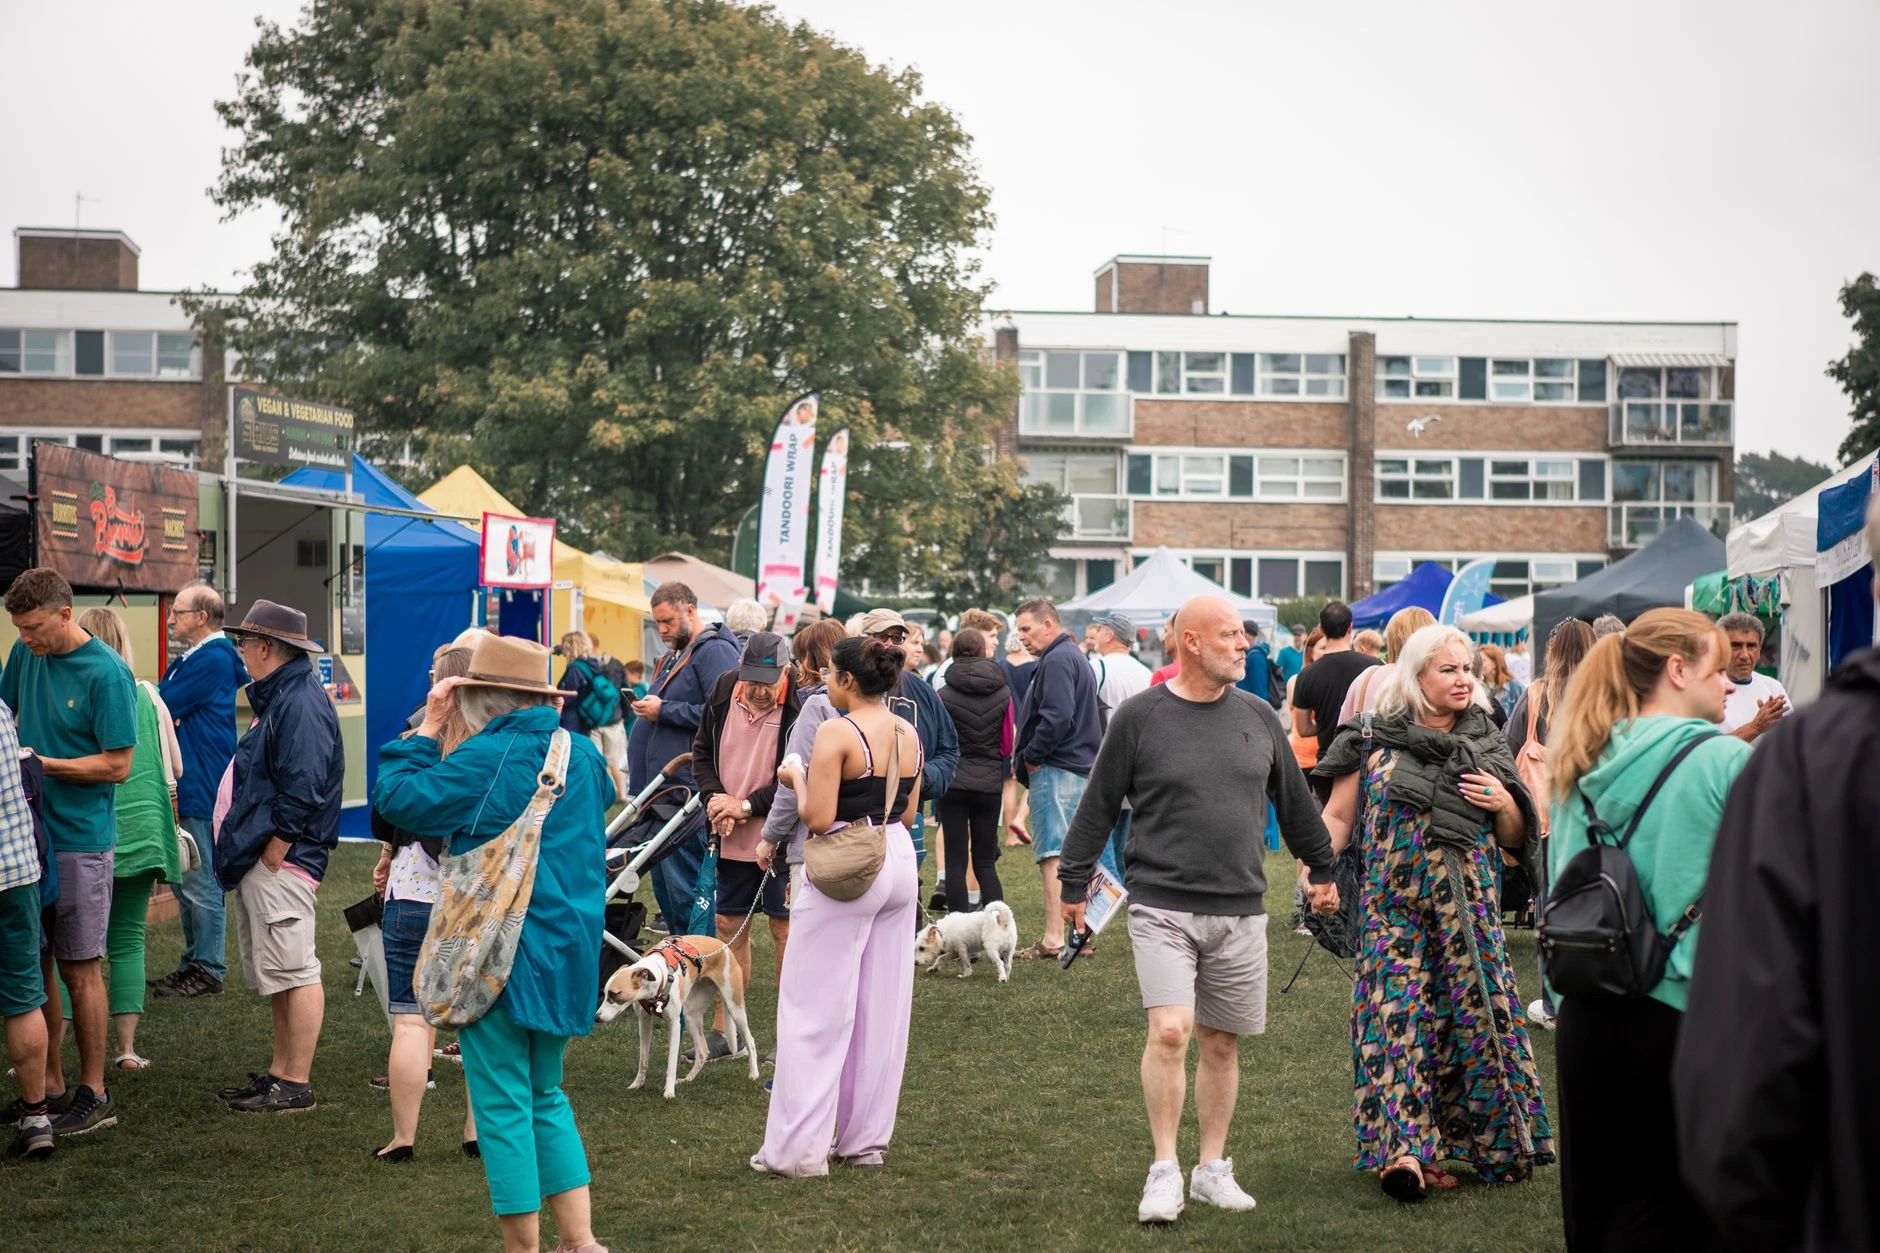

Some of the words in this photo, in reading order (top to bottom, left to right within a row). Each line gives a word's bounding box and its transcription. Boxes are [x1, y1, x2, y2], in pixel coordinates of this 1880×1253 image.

[257, 396, 283, 417] VEGAN
[283, 402, 290, 417] &
[291, 403, 333, 425] VEGETARIAN
[335, 411, 354, 428] FOOD
[786, 433, 798, 472] WRAP
[164, 518, 185, 538] NACHOS
[780, 476, 794, 545] TANDOORI
